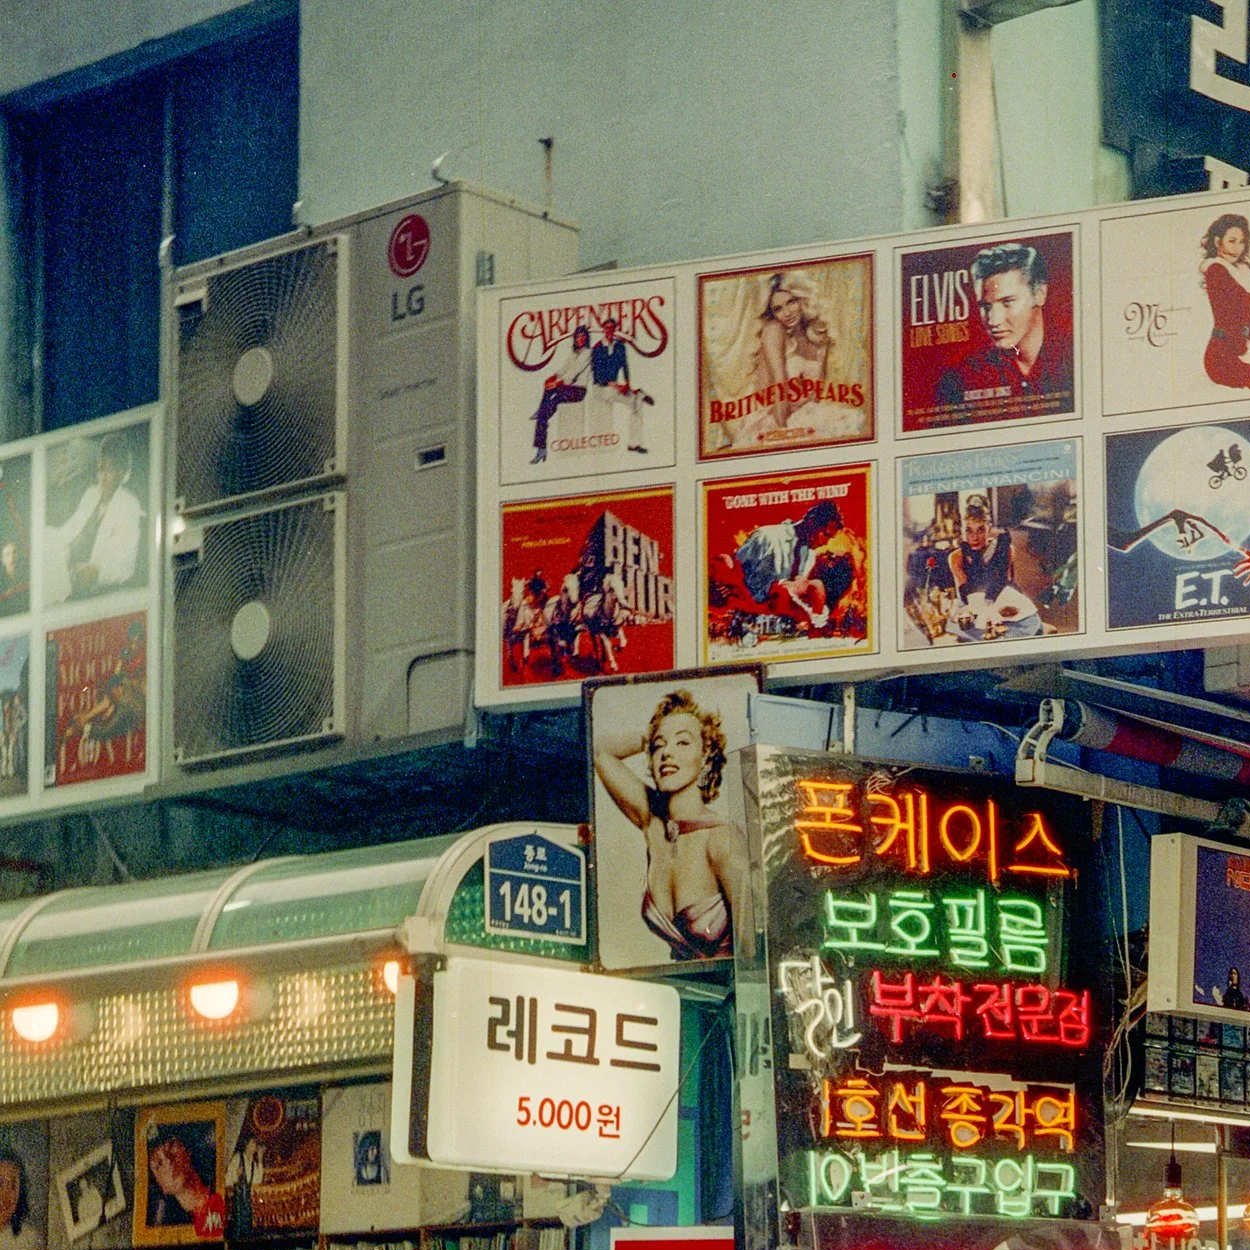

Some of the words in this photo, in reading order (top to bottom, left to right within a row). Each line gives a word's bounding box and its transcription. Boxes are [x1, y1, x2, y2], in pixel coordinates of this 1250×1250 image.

[392, 284, 426, 322] LG
[910, 268, 970, 327] ELVIS
[506, 295, 669, 372] CARPENTERS
[709, 378, 798, 424] BRITNEY
[787, 376, 864, 406] SPEARS
[550, 433, 620, 452] COLLECTED
[759, 491, 791, 505] WITH
[793, 488, 813, 503] THE
[908, 478, 980, 496] HENRY
[985, 470, 1071, 491] MANCINI
[1174, 567, 1233, 610] E.T.
[524, 844, 548, 862] 종로
[796, 778, 1073, 882] 폰케이스
[499, 880, 572, 930] 148-1
[822, 887, 1051, 974] 보호필름
[486, 995, 662, 1072] 레코드
[822, 1078, 927, 1141] 1호선
[941, 1083, 1077, 1152] 종각역
